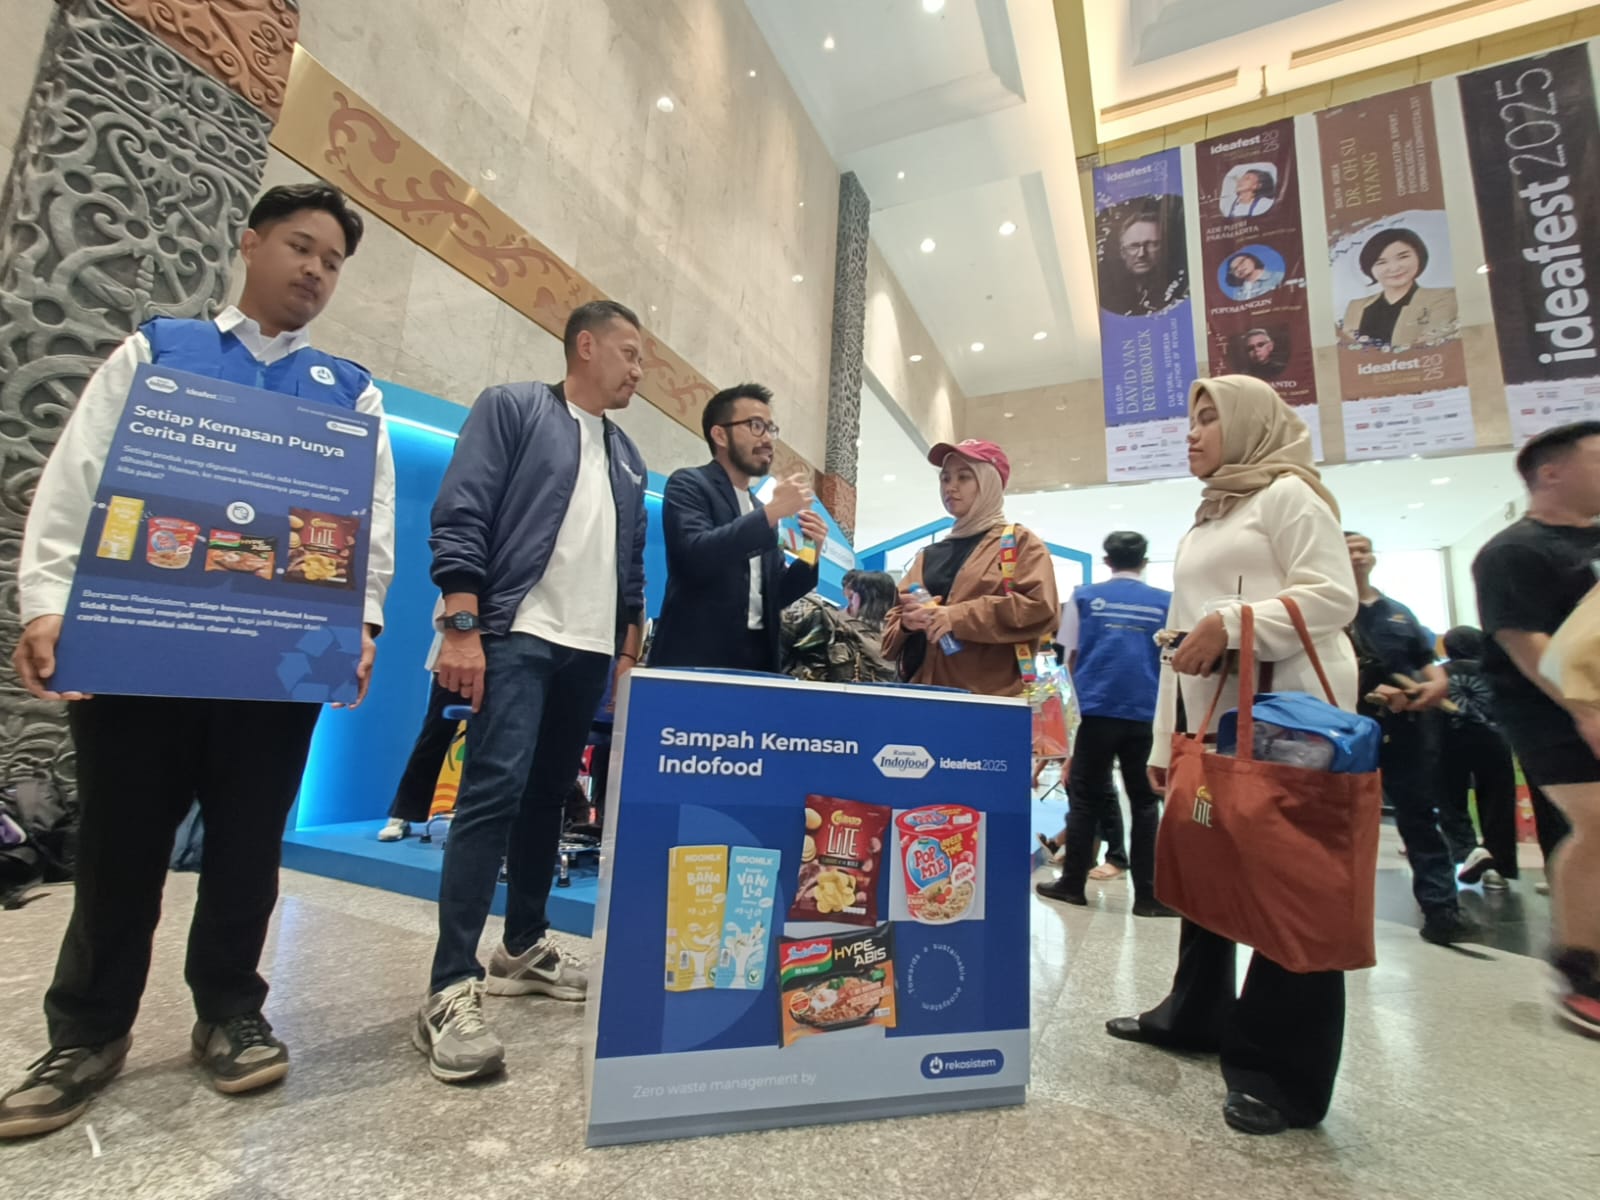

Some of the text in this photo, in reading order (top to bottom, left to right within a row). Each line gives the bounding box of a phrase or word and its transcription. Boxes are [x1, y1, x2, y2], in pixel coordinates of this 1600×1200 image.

[1210, 135, 1261, 155] ideafest
[1106, 164, 1153, 182] ideafest
[1342, 158, 1360, 182] OH
[1361, 151, 1382, 204] HYANG
[1121, 338, 1139, 414] DAVID VAN
[1137, 328, 1156, 411] REYBROUCK
[1357, 358, 1421, 375] ideafest
[129, 422, 237, 453] Cerita Baru
[133, 404, 345, 457] Setiap Kemasan Punya
[660, 727, 859, 754] Sampah Kemasan
[658, 754, 763, 776] Indofood
[880, 756, 929, 772] Indofood
[834, 938, 876, 961] HYPE
[853, 946, 887, 968] ABIS
[933, 943, 967, 982] sustainable
[921, 986, 963, 1011] ecosystem
[945, 1058, 997, 1071] rekosistem
[632, 1070, 817, 1099] Zero waste management by
